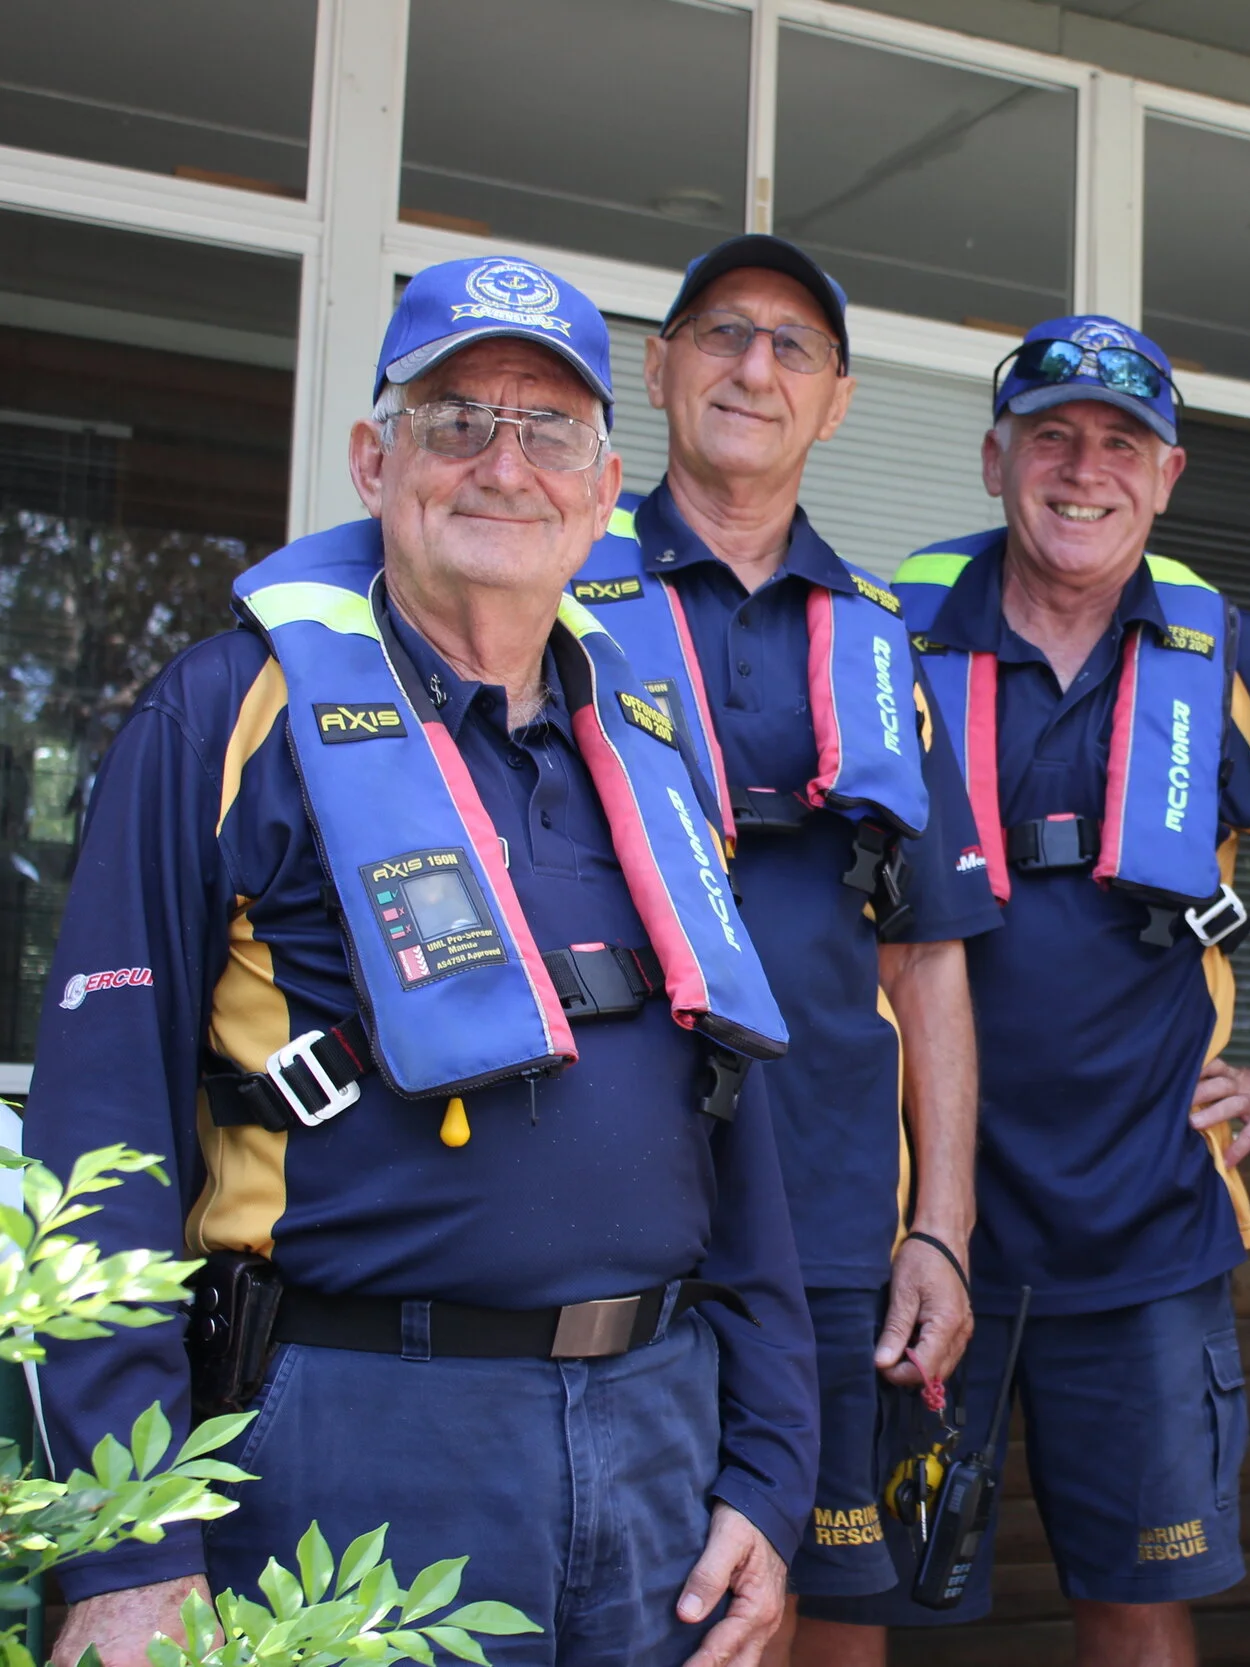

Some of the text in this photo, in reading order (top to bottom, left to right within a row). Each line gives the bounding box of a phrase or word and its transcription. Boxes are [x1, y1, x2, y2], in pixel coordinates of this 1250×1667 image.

[575, 581, 640, 598] AXIS
[873, 635, 901, 756] RESCUE
[321, 706, 400, 733] AXIS
[653, 721, 672, 742] 200
[1165, 699, 1191, 833] RESCUE
[372, 853, 459, 882] AXIS 150N
[666, 786, 743, 952] RESCUE
[426, 940, 447, 952] UML
[814, 1503, 879, 1528] MARIN
[815, 1521, 884, 1546] RESCU
[1140, 1519, 1204, 1543] ARINE
